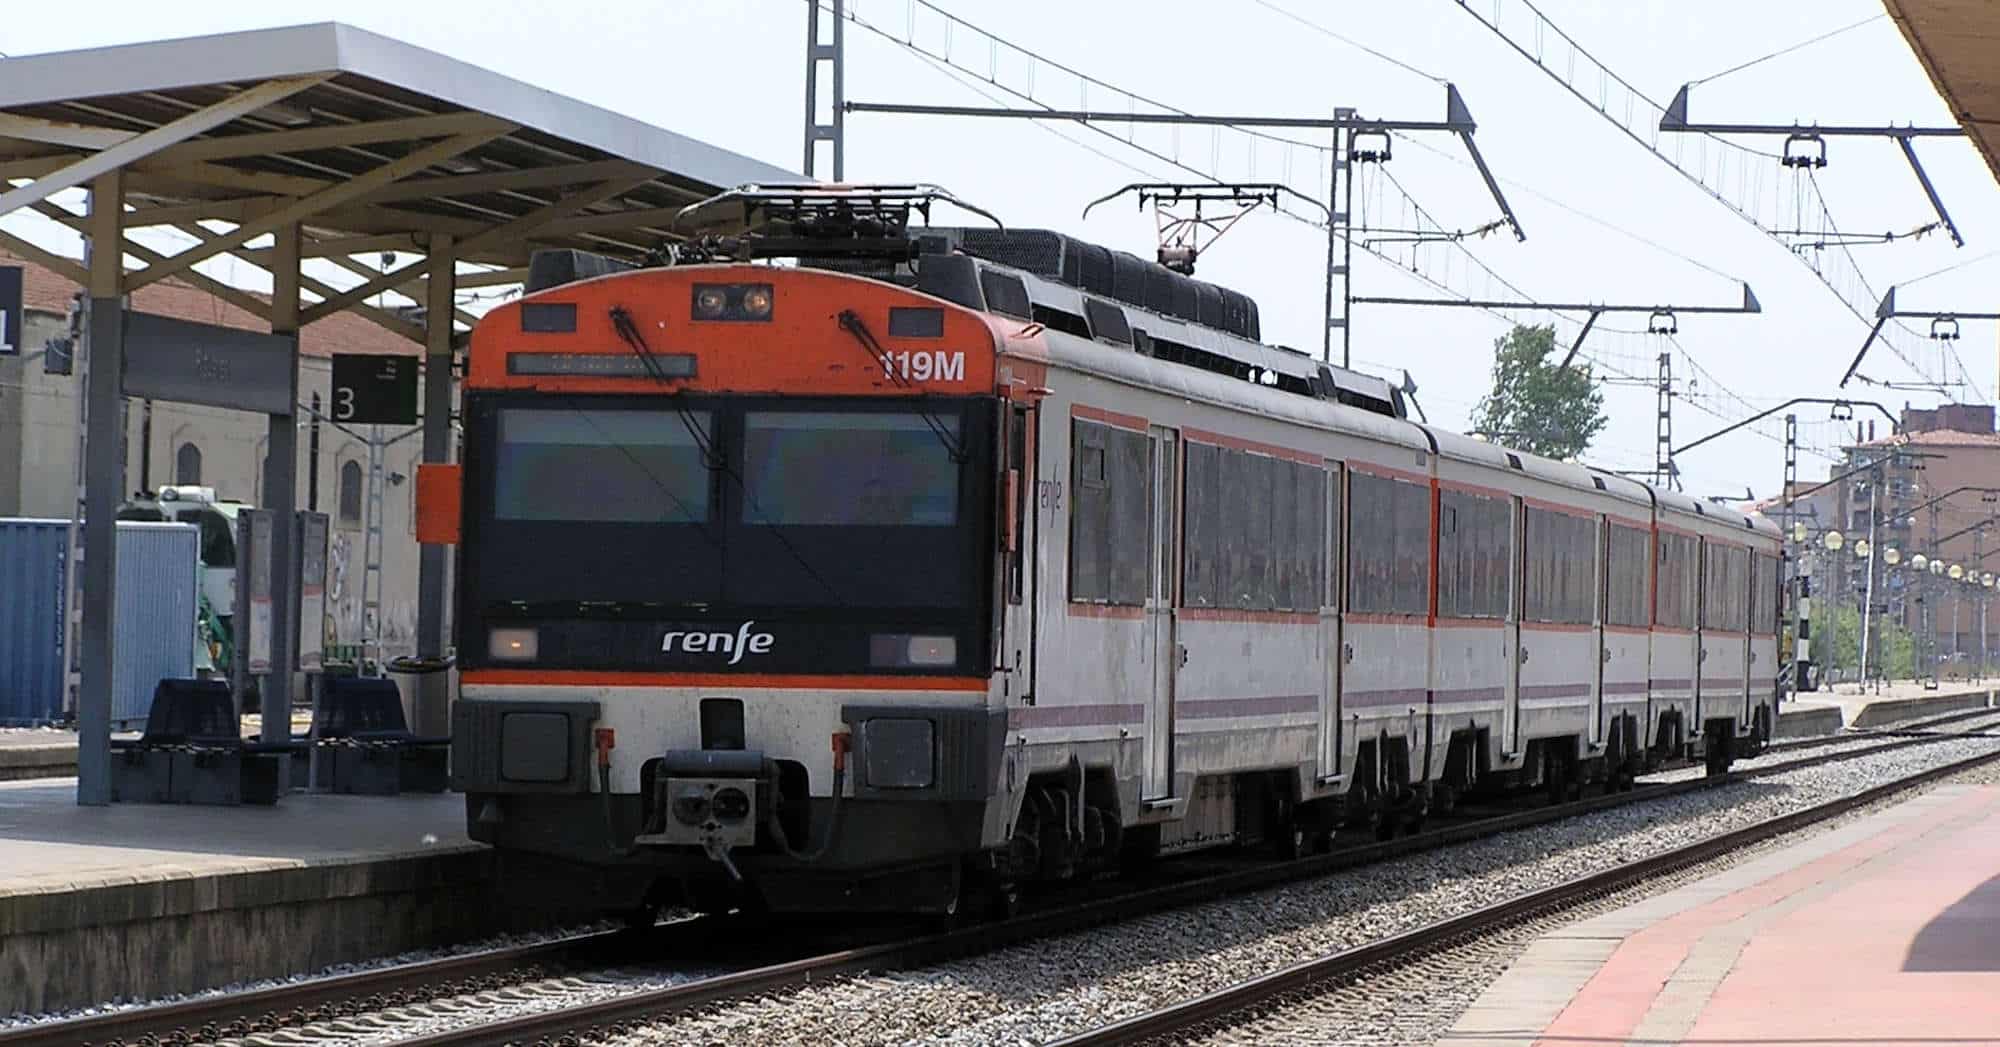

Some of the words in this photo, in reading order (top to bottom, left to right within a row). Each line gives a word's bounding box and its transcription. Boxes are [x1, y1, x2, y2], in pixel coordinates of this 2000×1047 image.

[880, 351, 965, 381] 119M
[337, 387, 354, 419] 3
[661, 620, 775, 665] renfe
